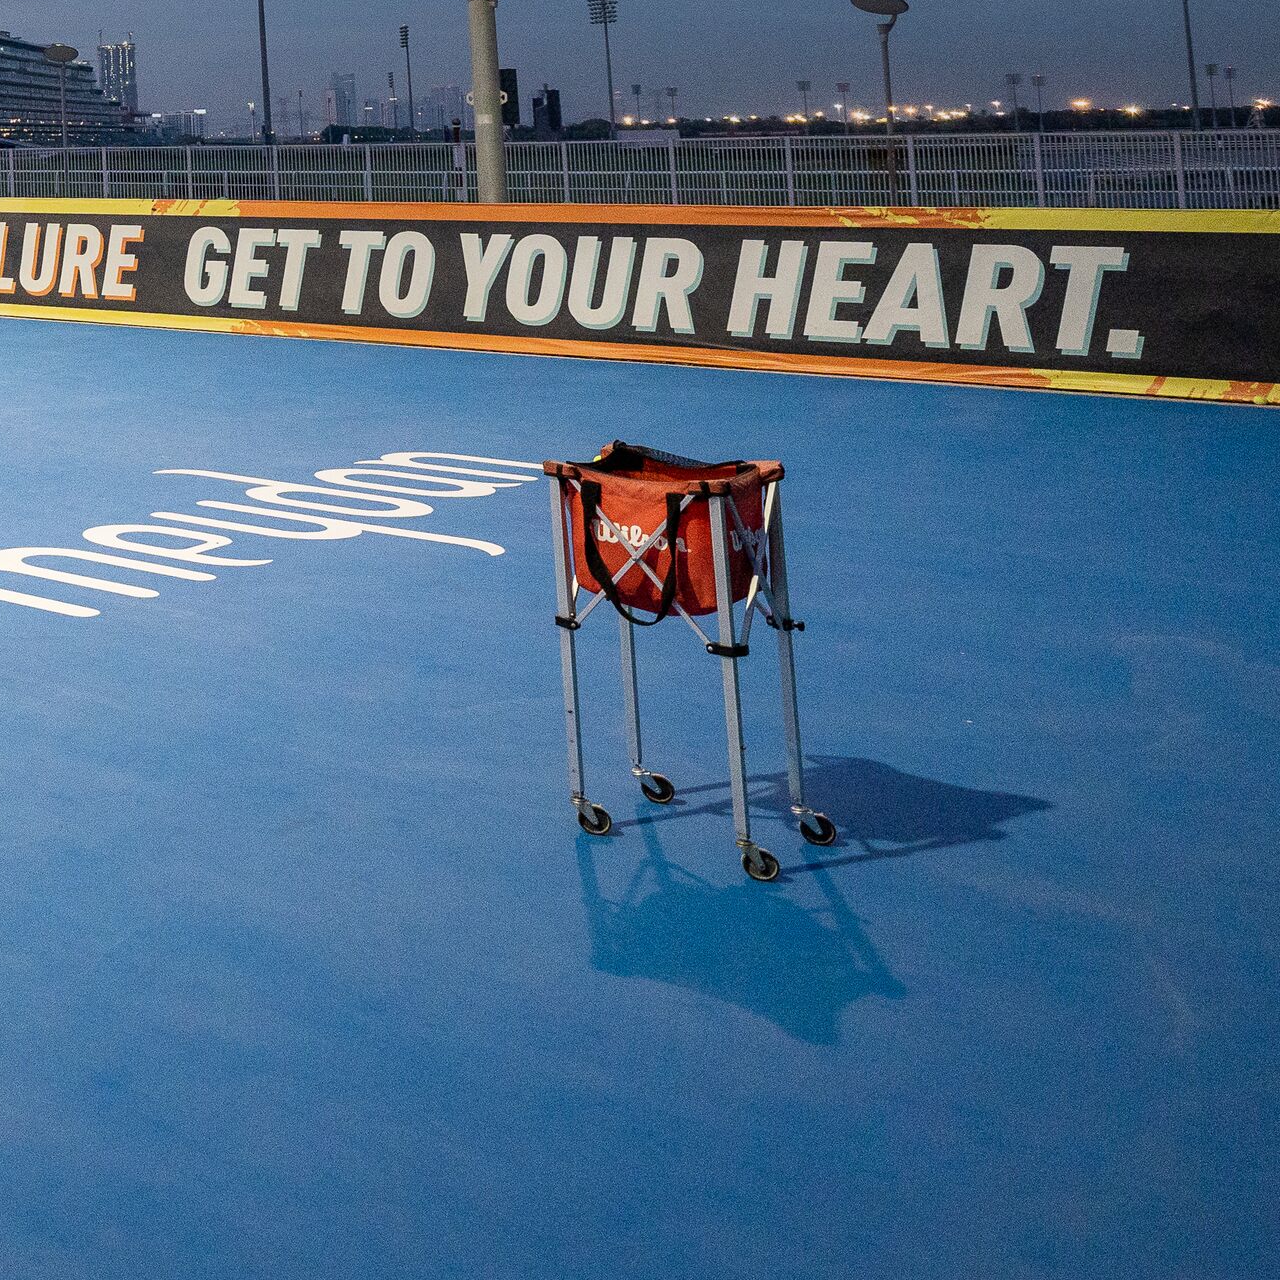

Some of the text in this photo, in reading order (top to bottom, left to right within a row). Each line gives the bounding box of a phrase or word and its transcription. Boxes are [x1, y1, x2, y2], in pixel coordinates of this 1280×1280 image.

[183, 226, 321, 311] GET
[339, 230, 435, 319] TO
[461, 233, 704, 334] YOUR
[727, 238, 1146, 360] HEART.
